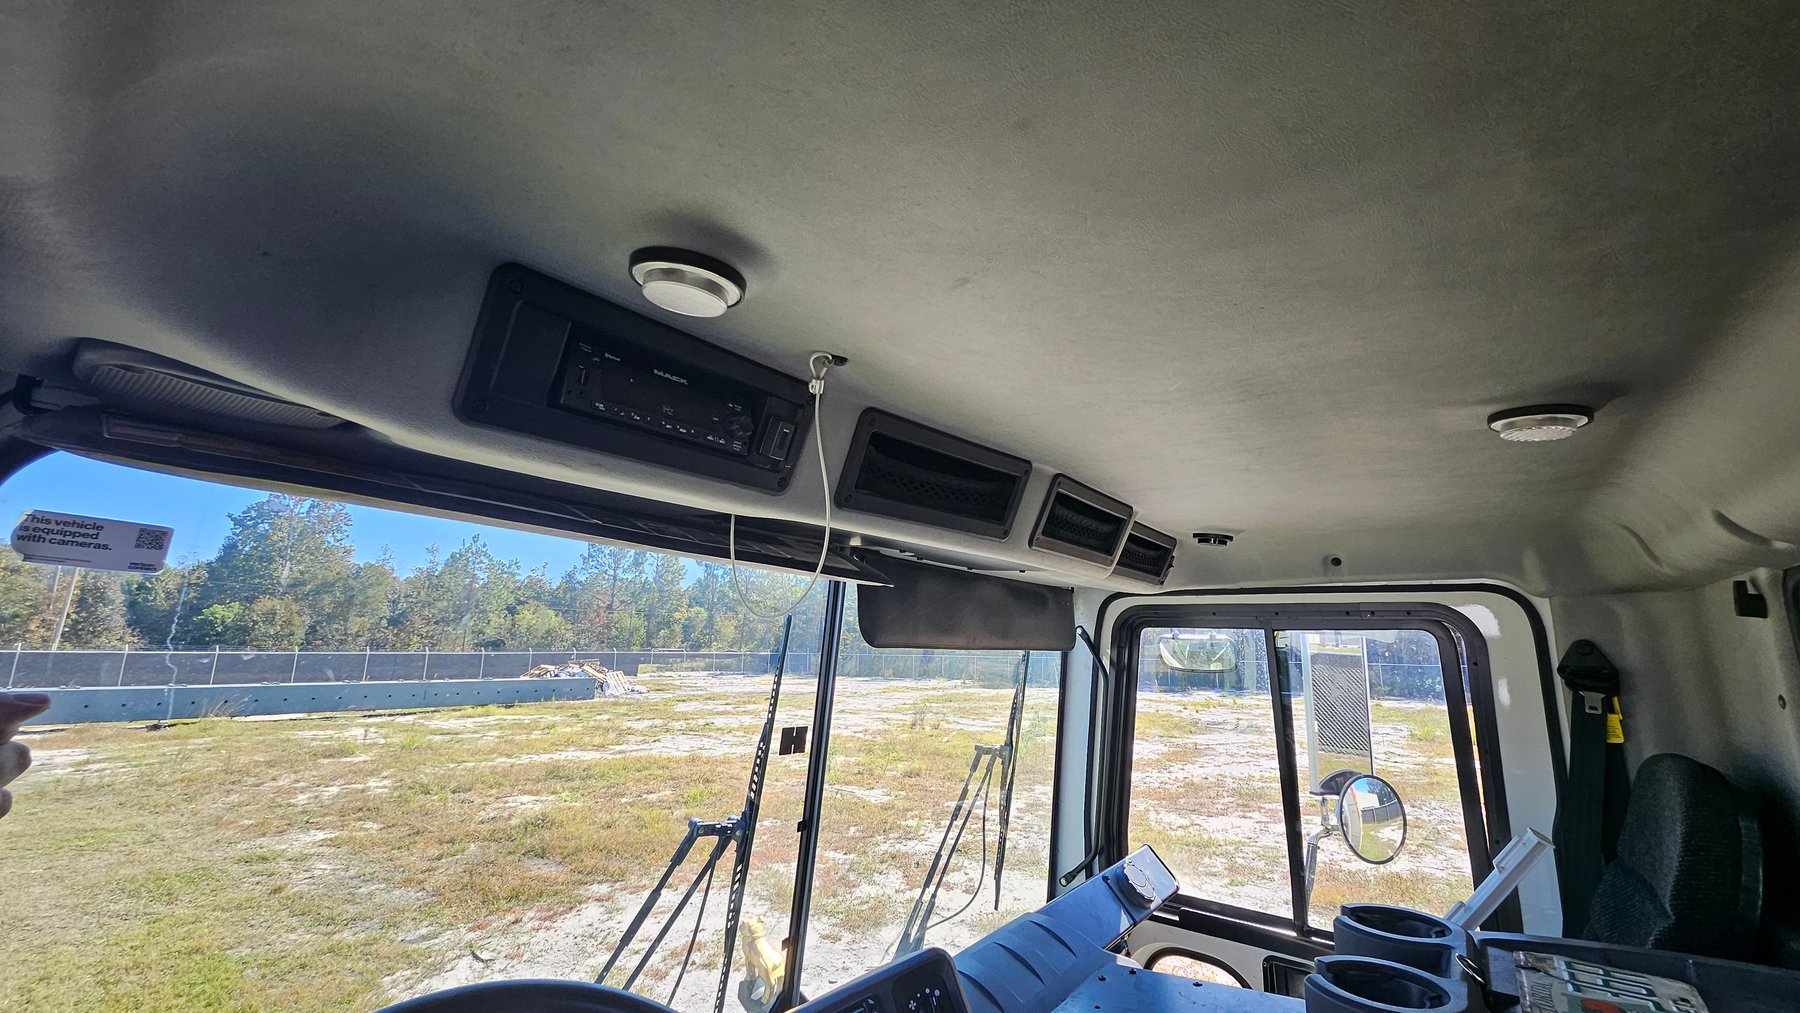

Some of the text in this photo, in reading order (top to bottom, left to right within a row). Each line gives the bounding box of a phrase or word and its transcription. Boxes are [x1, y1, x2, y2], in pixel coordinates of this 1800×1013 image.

[653, 369, 688, 385] MACK
[25, 513, 104, 532] This vehicle
[19, 524, 100, 540] is equipped
[16, 532, 113, 551] with cameras.
